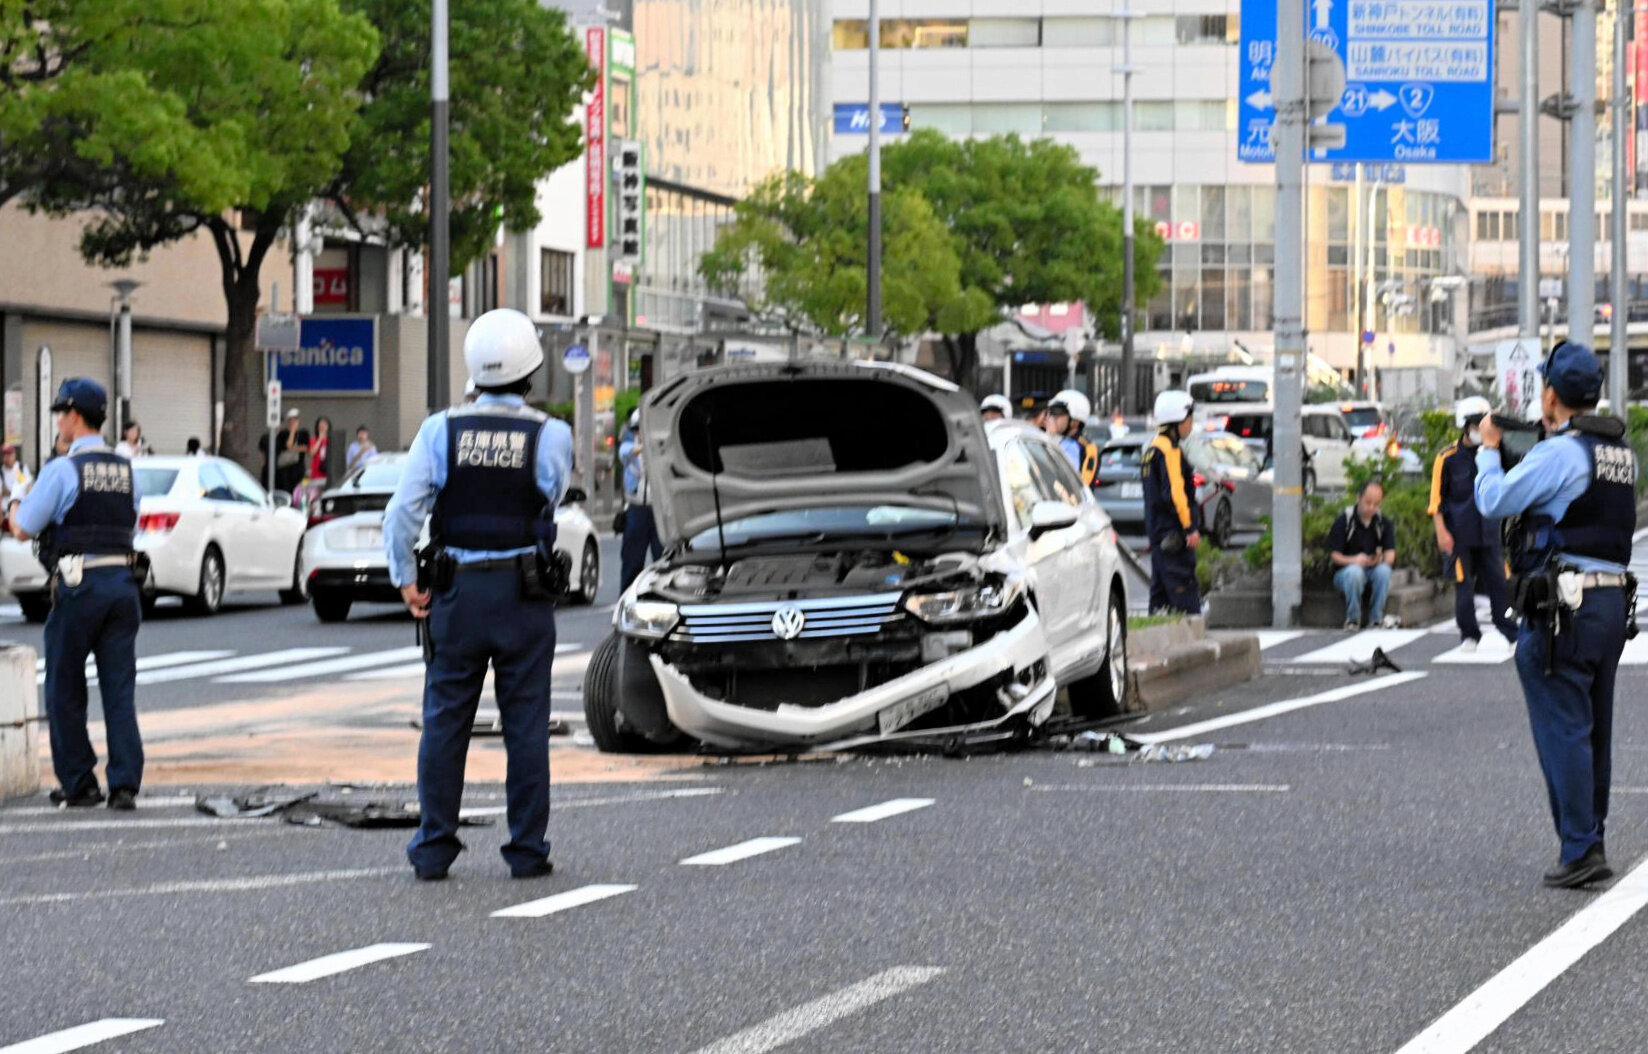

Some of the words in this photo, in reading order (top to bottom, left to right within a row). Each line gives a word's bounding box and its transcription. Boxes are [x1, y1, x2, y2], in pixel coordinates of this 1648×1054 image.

[1416, 24, 1443, 34] TOLL
[1448, 24, 1481, 34] ROAD
[1415, 67, 1441, 77] TOLL
[1447, 67, 1479, 77] ROAD
[1343, 89, 1364, 111] 21
[1410, 88, 1423, 109] 2
[1391, 118, 1440, 144] 大阪
[1394, 144, 1436, 160] Osaka
[457, 447, 524, 469] POLICE
[84, 476, 130, 494] POLICE
